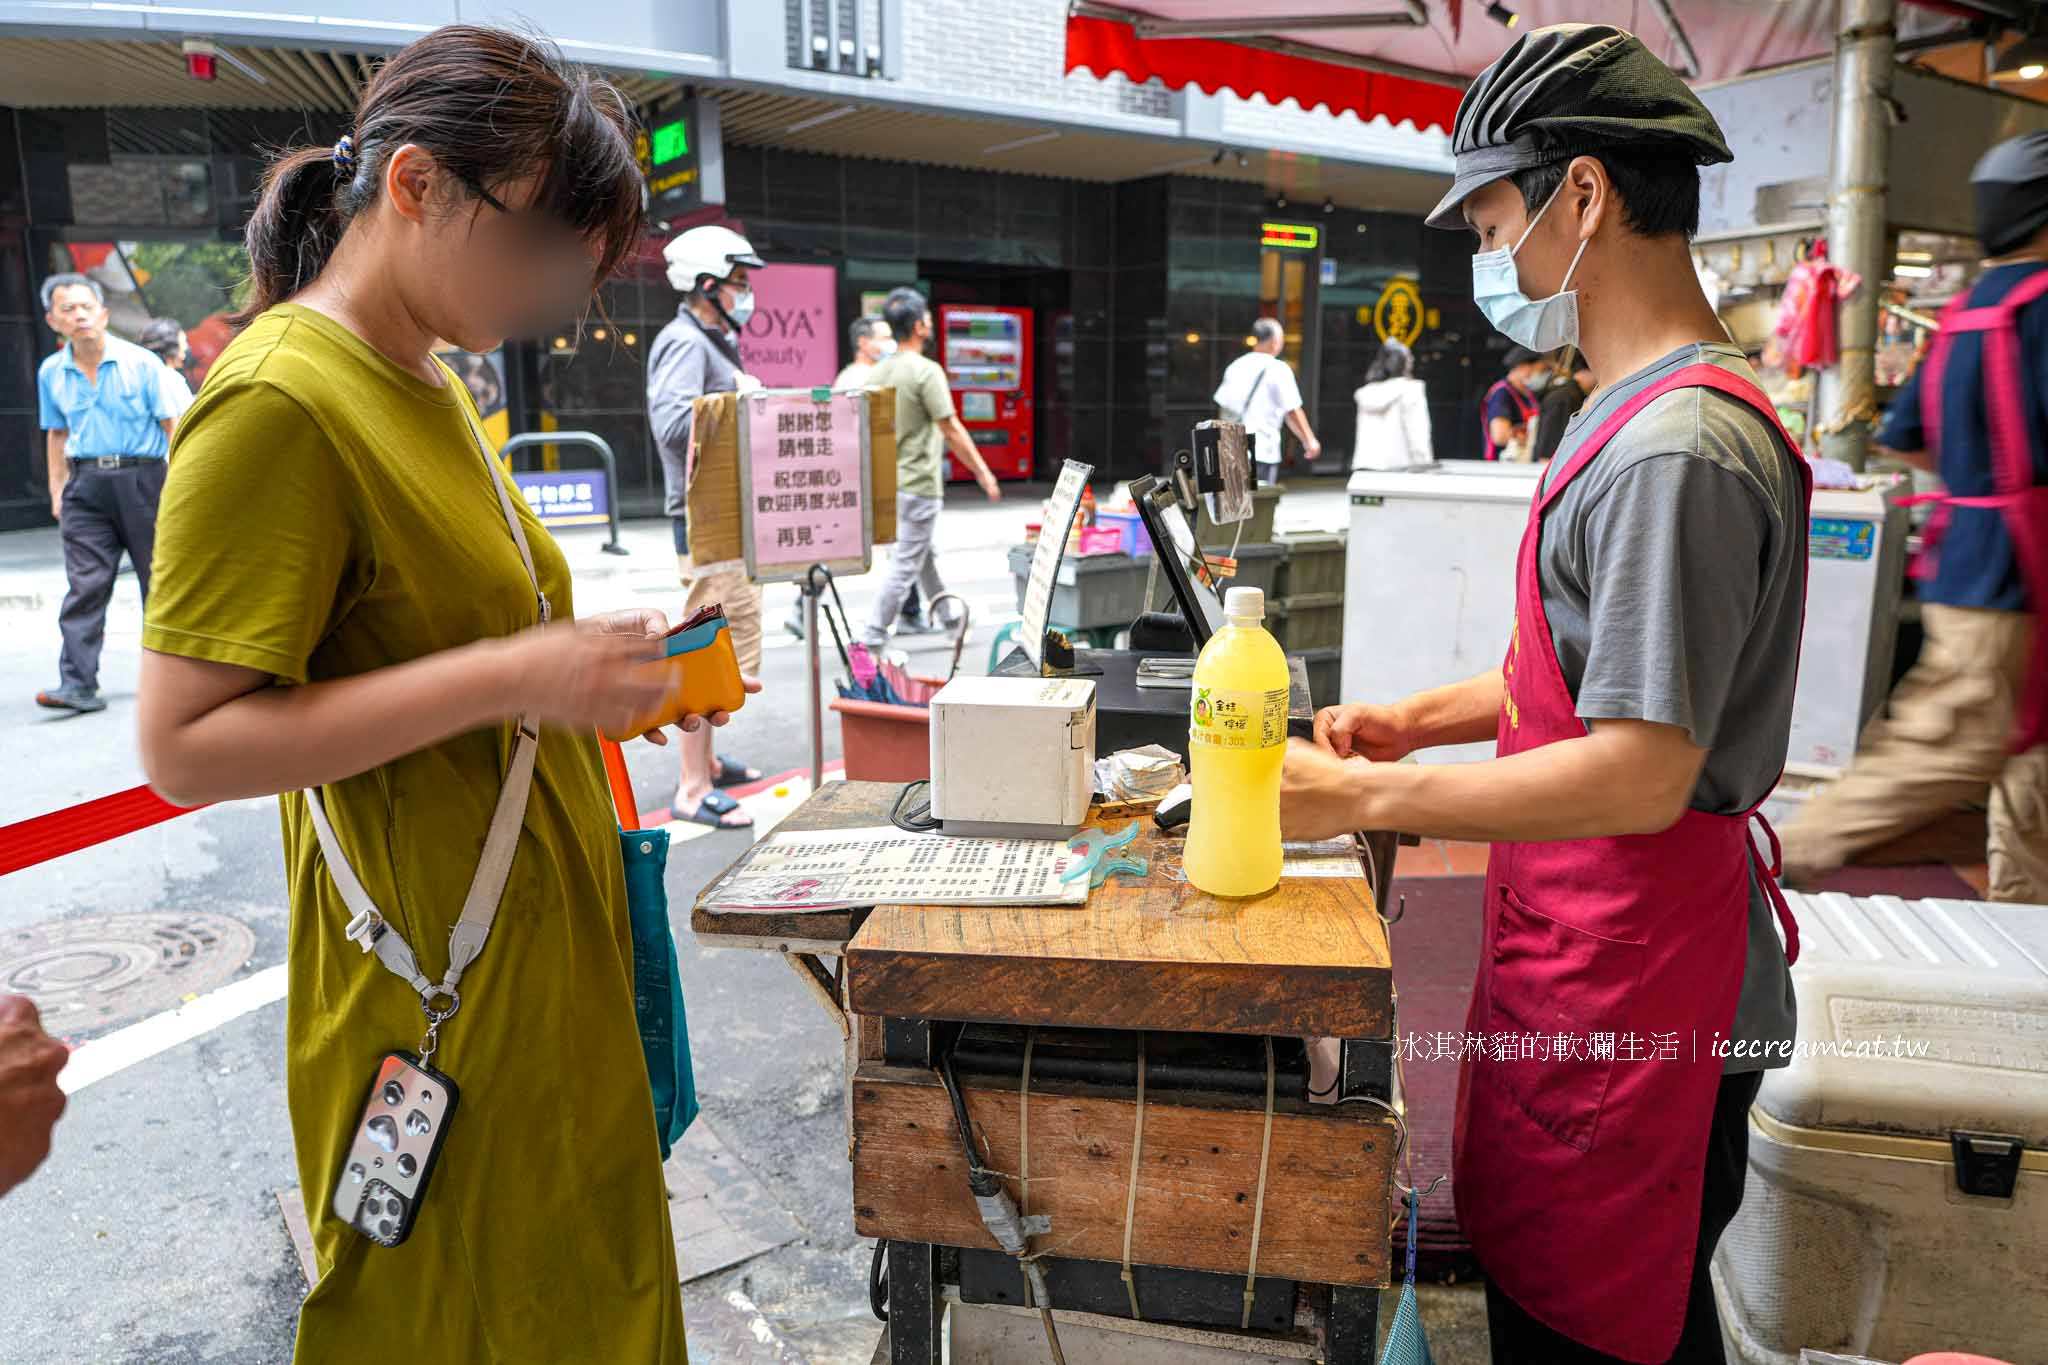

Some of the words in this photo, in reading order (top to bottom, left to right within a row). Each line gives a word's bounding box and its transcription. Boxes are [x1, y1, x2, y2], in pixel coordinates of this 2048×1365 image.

[747, 308, 815, 338] OYA
[777, 411, 833, 433] 謝謝您
[777, 437, 834, 458] 請慢走
[774, 469, 842, 489] 祝您順心
[757, 491, 858, 513] 歡迎再度光臨
